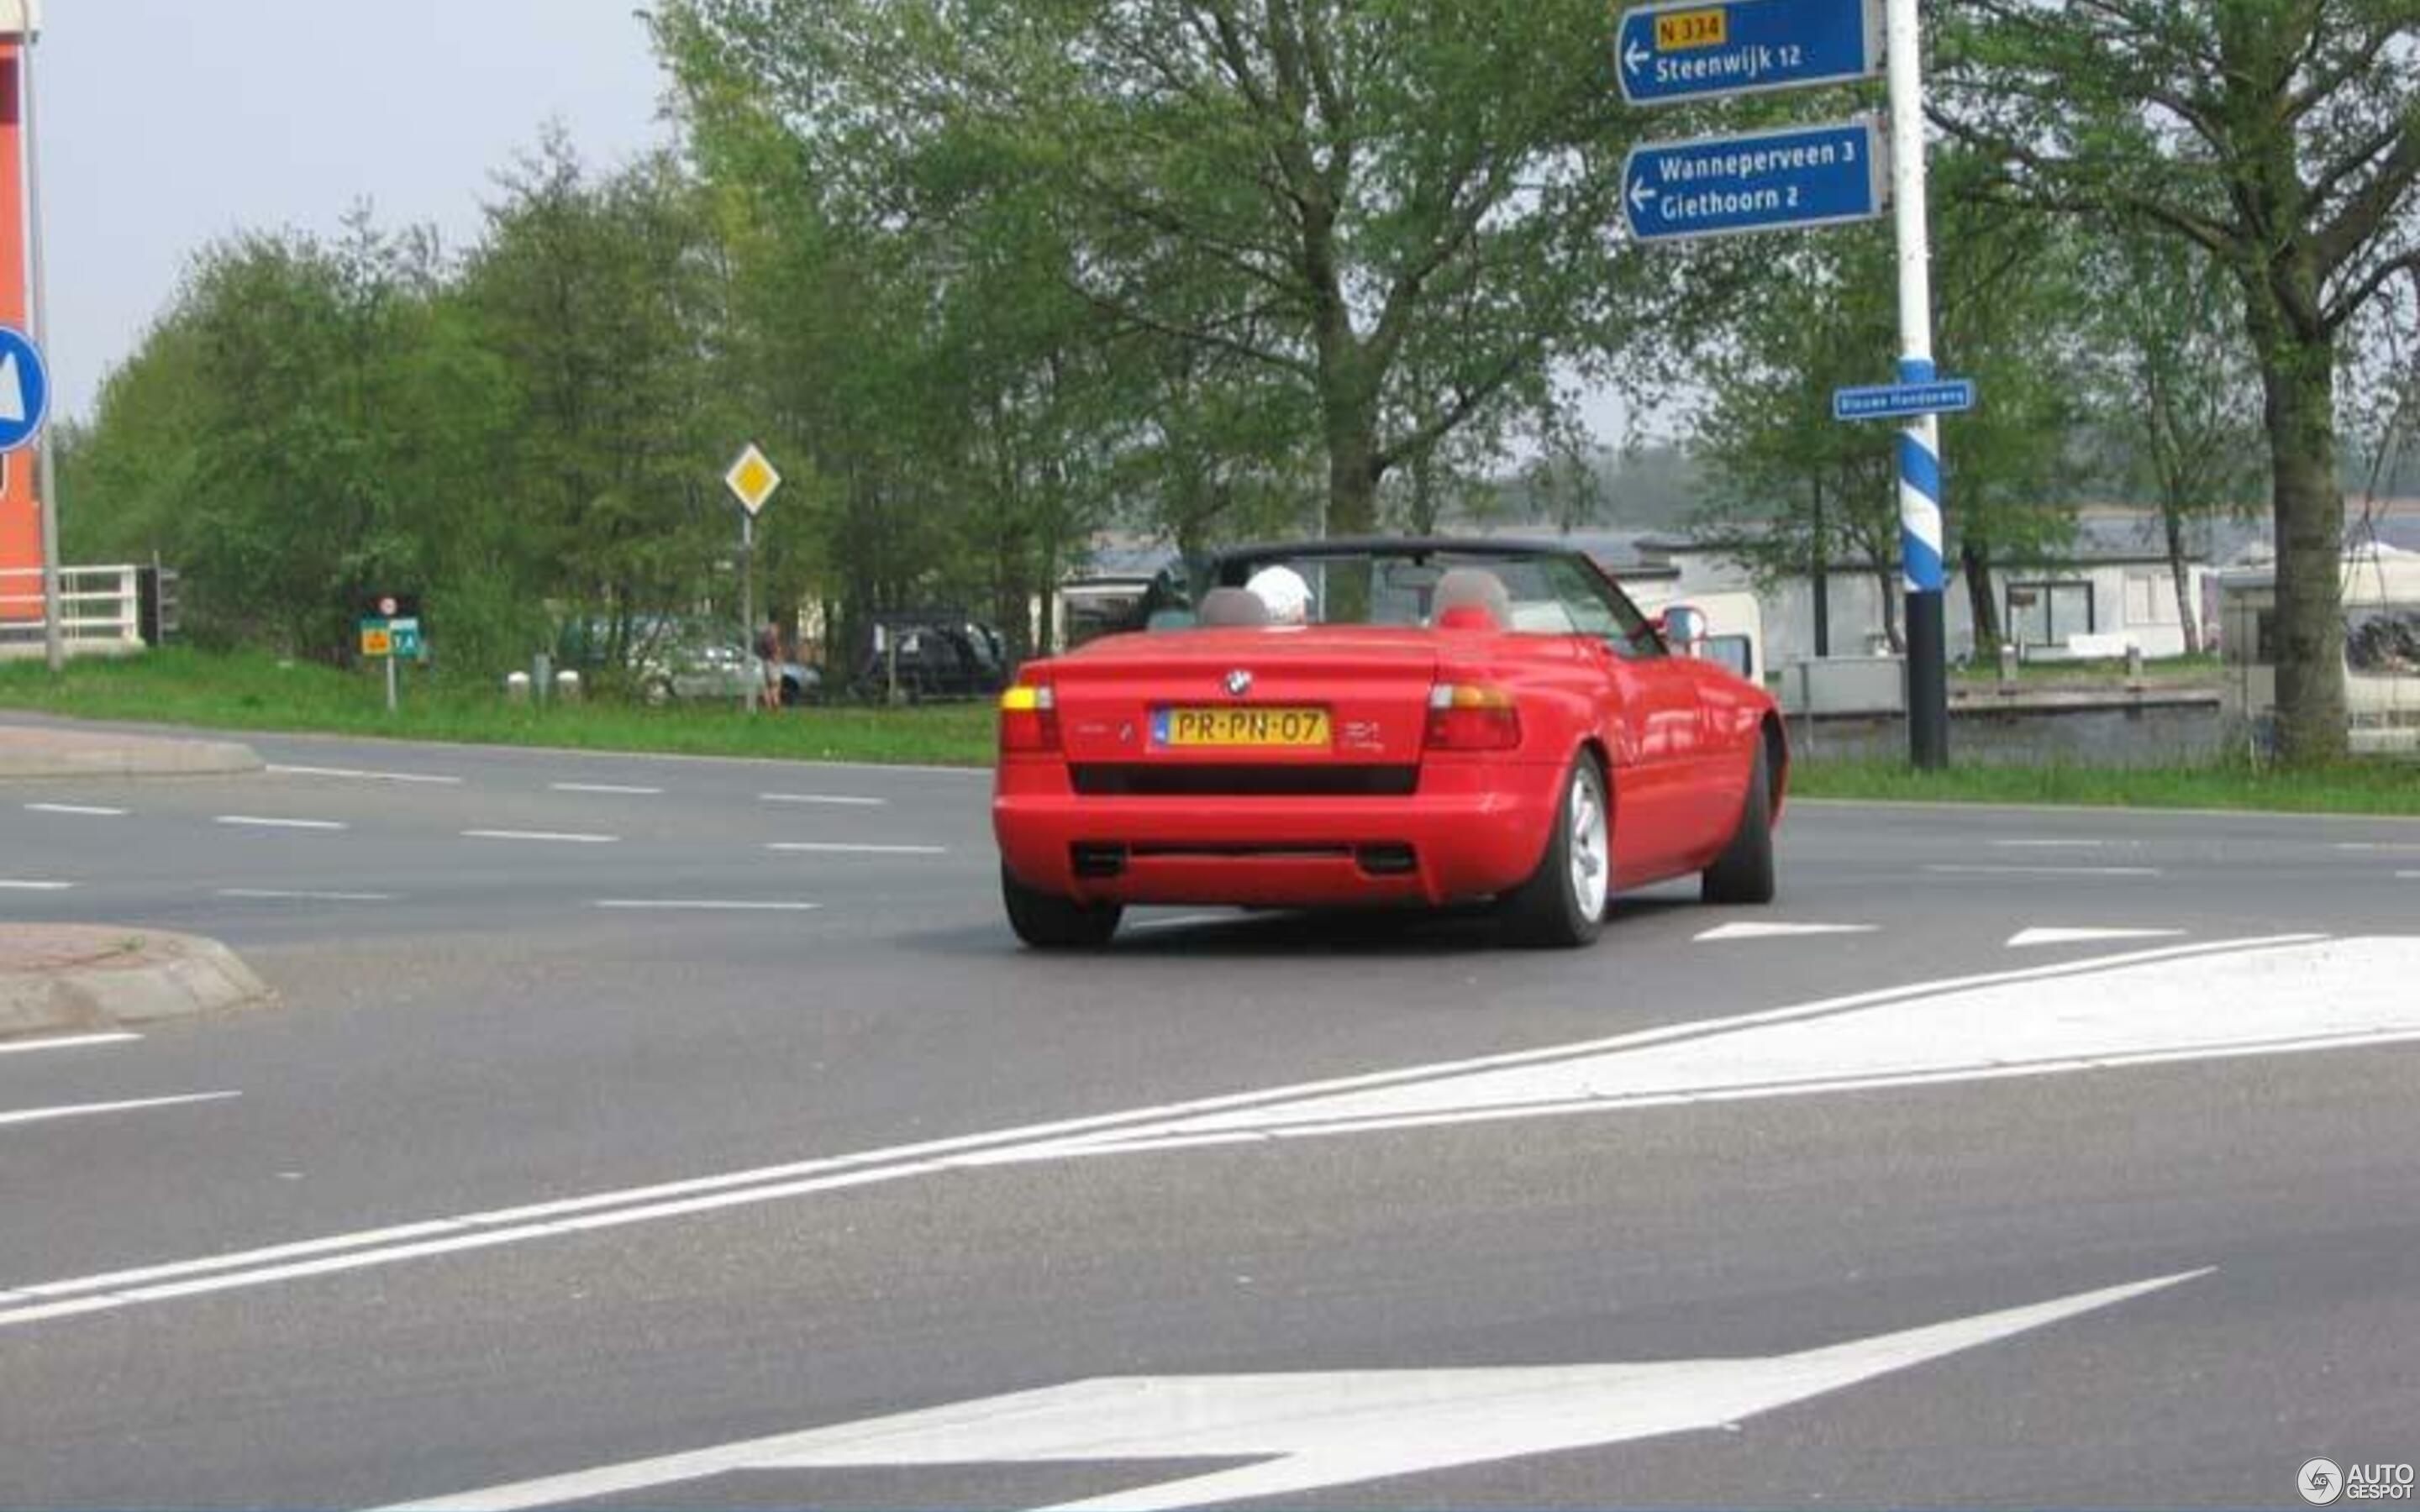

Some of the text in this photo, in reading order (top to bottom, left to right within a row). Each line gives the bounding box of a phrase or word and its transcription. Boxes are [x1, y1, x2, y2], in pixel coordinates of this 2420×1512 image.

[1660, 16, 1720, 42] N 334
[1655, 45, 1802, 82] Steenwijk 12
[1660, 140, 1855, 182] Wanneperveen 3
[1660, 186, 1799, 221] Giethoorn 2
[1178, 712, 1320, 741] PR-PN-07
